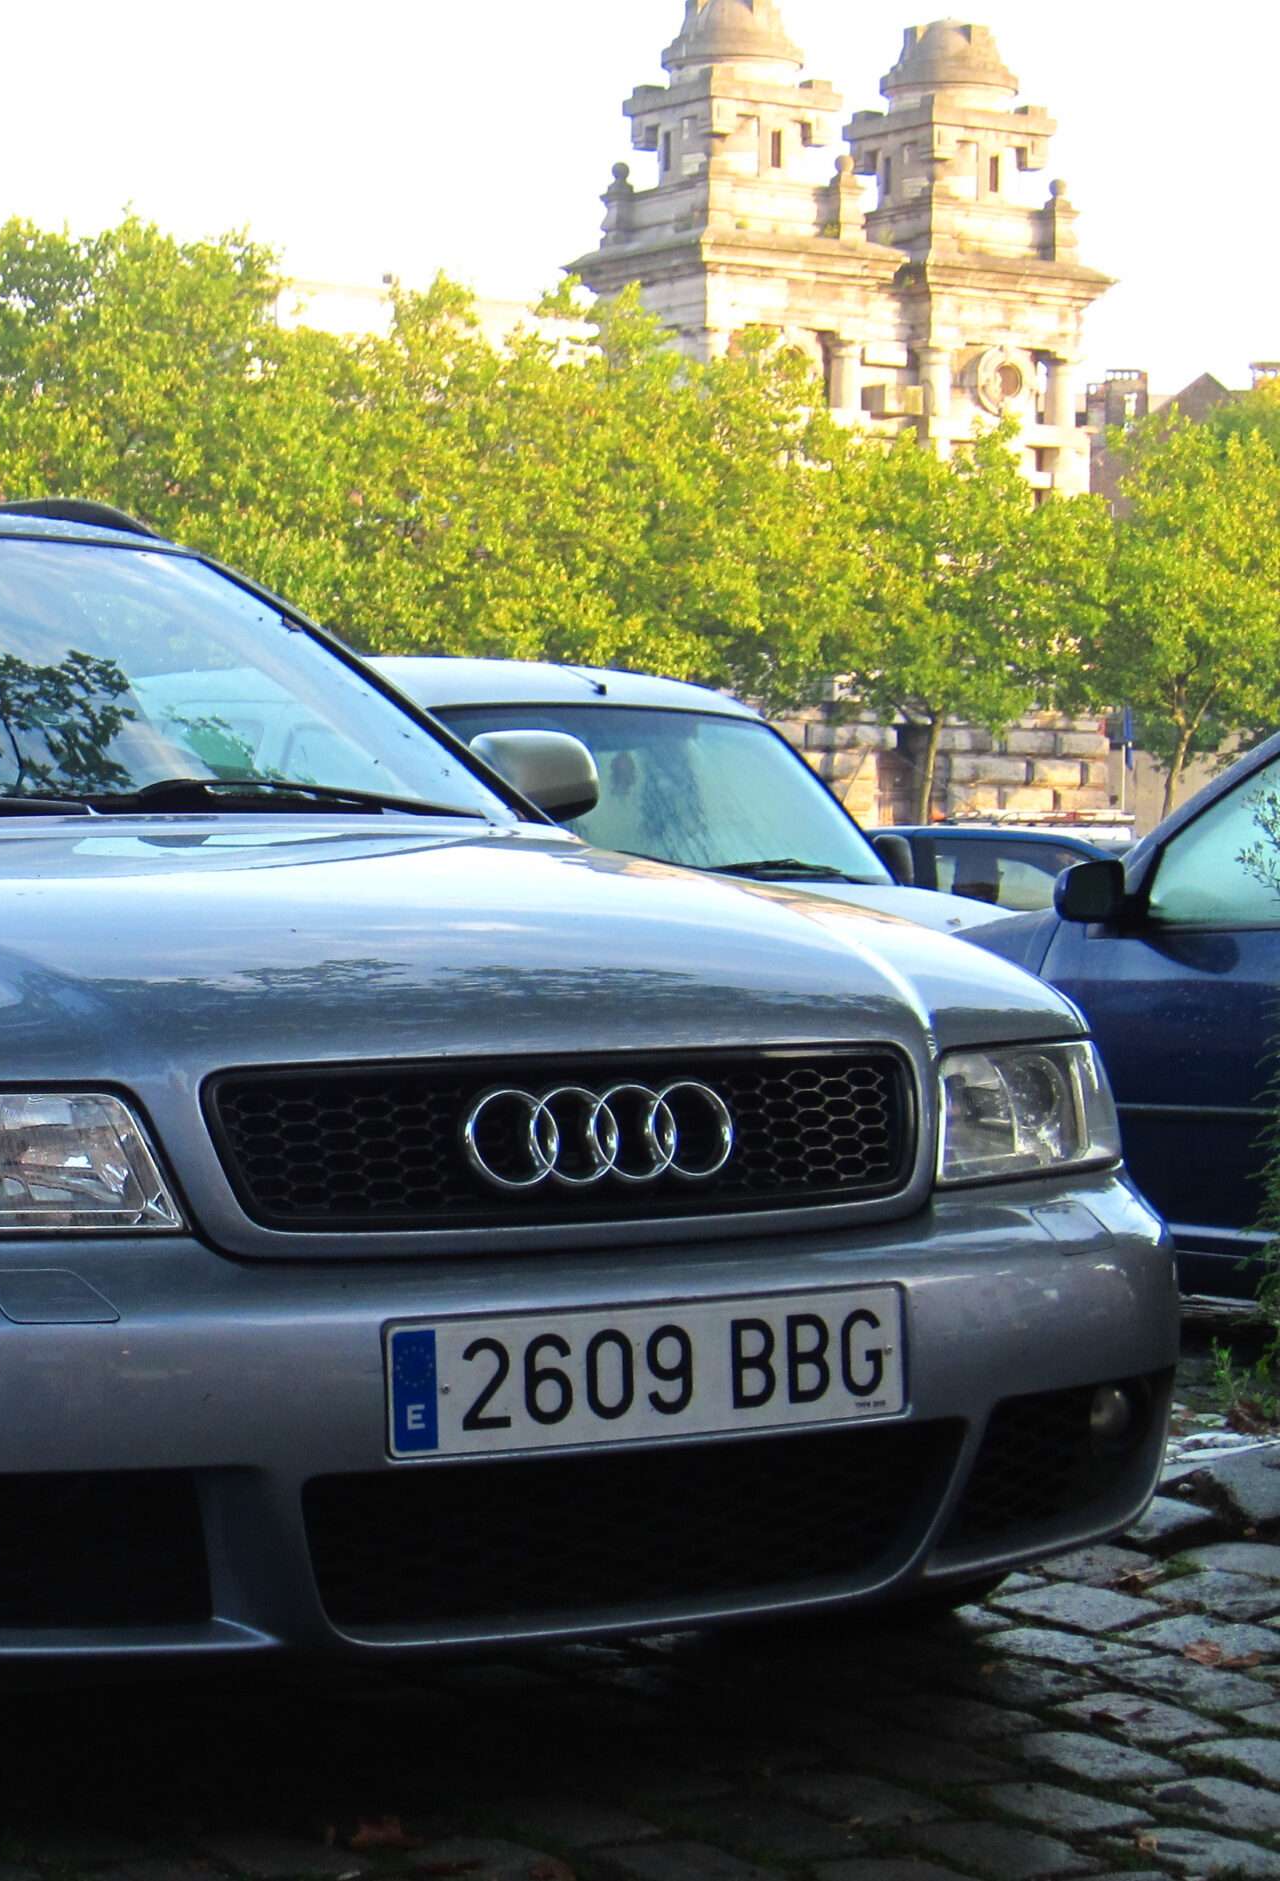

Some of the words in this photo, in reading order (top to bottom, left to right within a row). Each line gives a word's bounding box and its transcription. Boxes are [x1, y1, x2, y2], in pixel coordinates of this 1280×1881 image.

[461, 1325, 694, 1432] 2609
[730, 1308, 884, 1410] BBG
[407, 1404, 426, 1430] E
